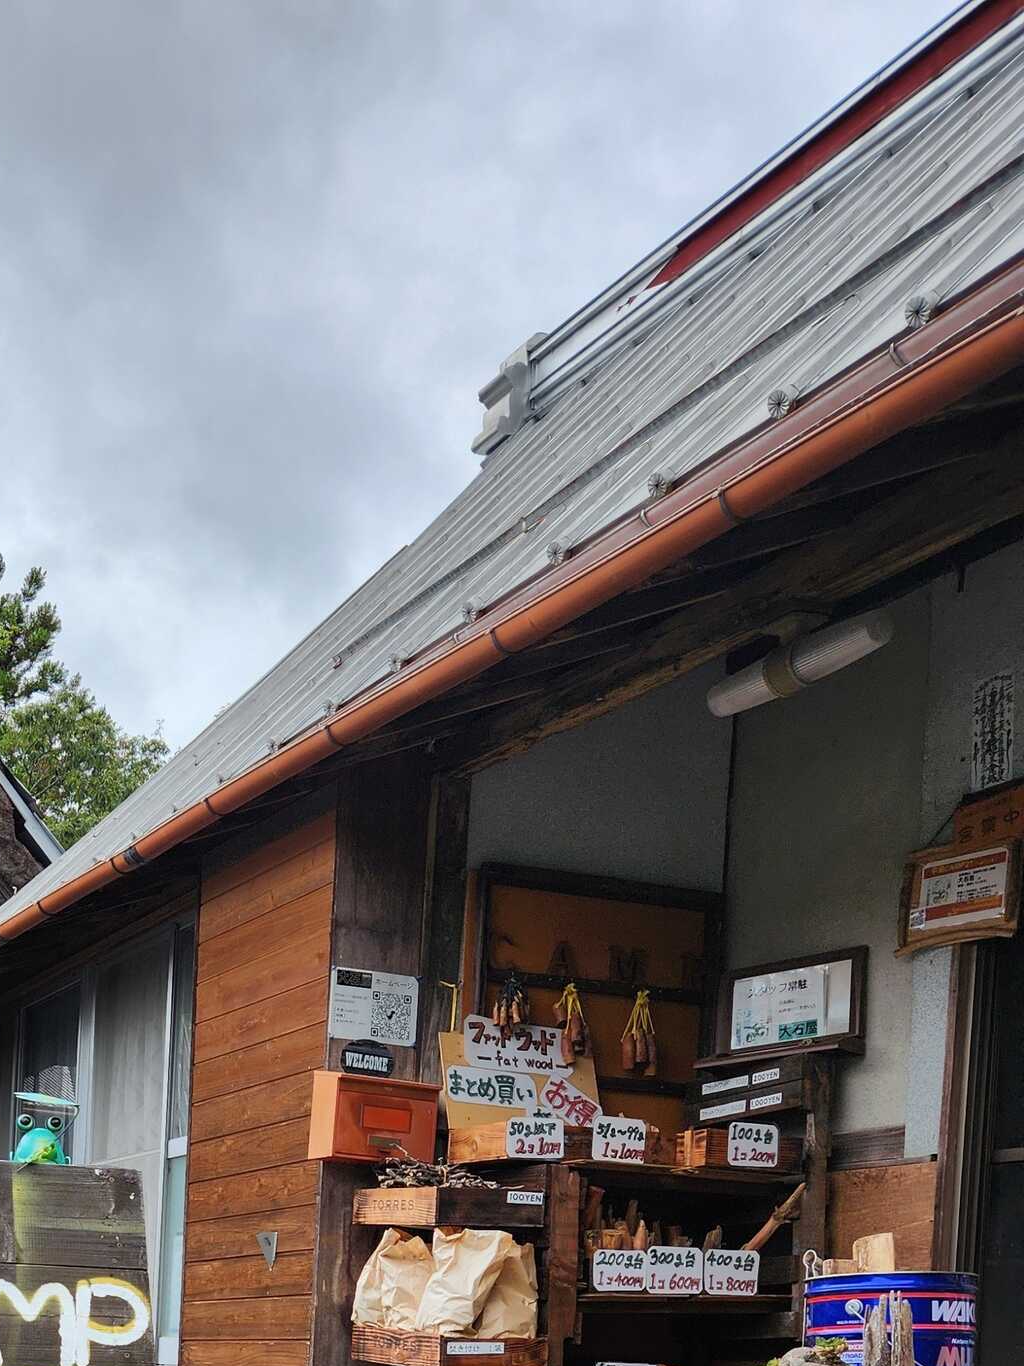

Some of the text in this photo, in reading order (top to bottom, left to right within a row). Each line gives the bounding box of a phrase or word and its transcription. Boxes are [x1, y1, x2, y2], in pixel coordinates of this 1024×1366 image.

[345, 1051, 389, 1073] WELCOME
[525, 1057, 553, 1070] wood
[449, 1069, 533, 1105] まとめ買い
[545, 1079, 598, 1127] お得
[373, 1199, 415, 1211] TORRES
[509, 1192, 542, 1203] 100YEN
[649, 1248, 696, 1268] 300g台
[706, 1250, 756, 1272] 400g台
